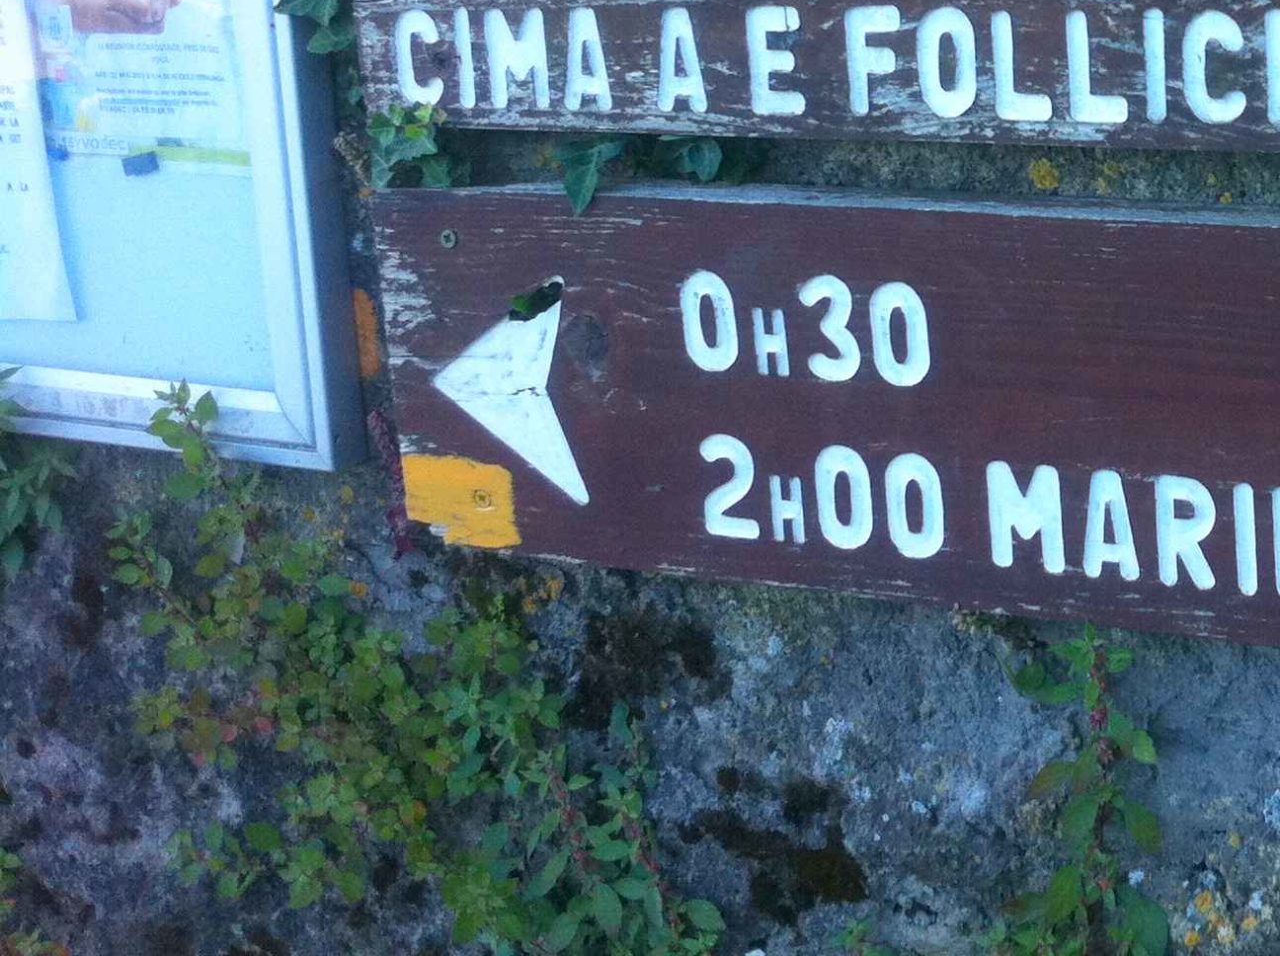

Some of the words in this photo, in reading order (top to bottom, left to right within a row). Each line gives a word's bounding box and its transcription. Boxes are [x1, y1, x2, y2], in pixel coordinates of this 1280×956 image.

[394, 6, 613, 112] CIMA
[658, 7, 709, 114] A
[745, 4, 806, 117] E
[699, 434, 945, 559] 2H00
